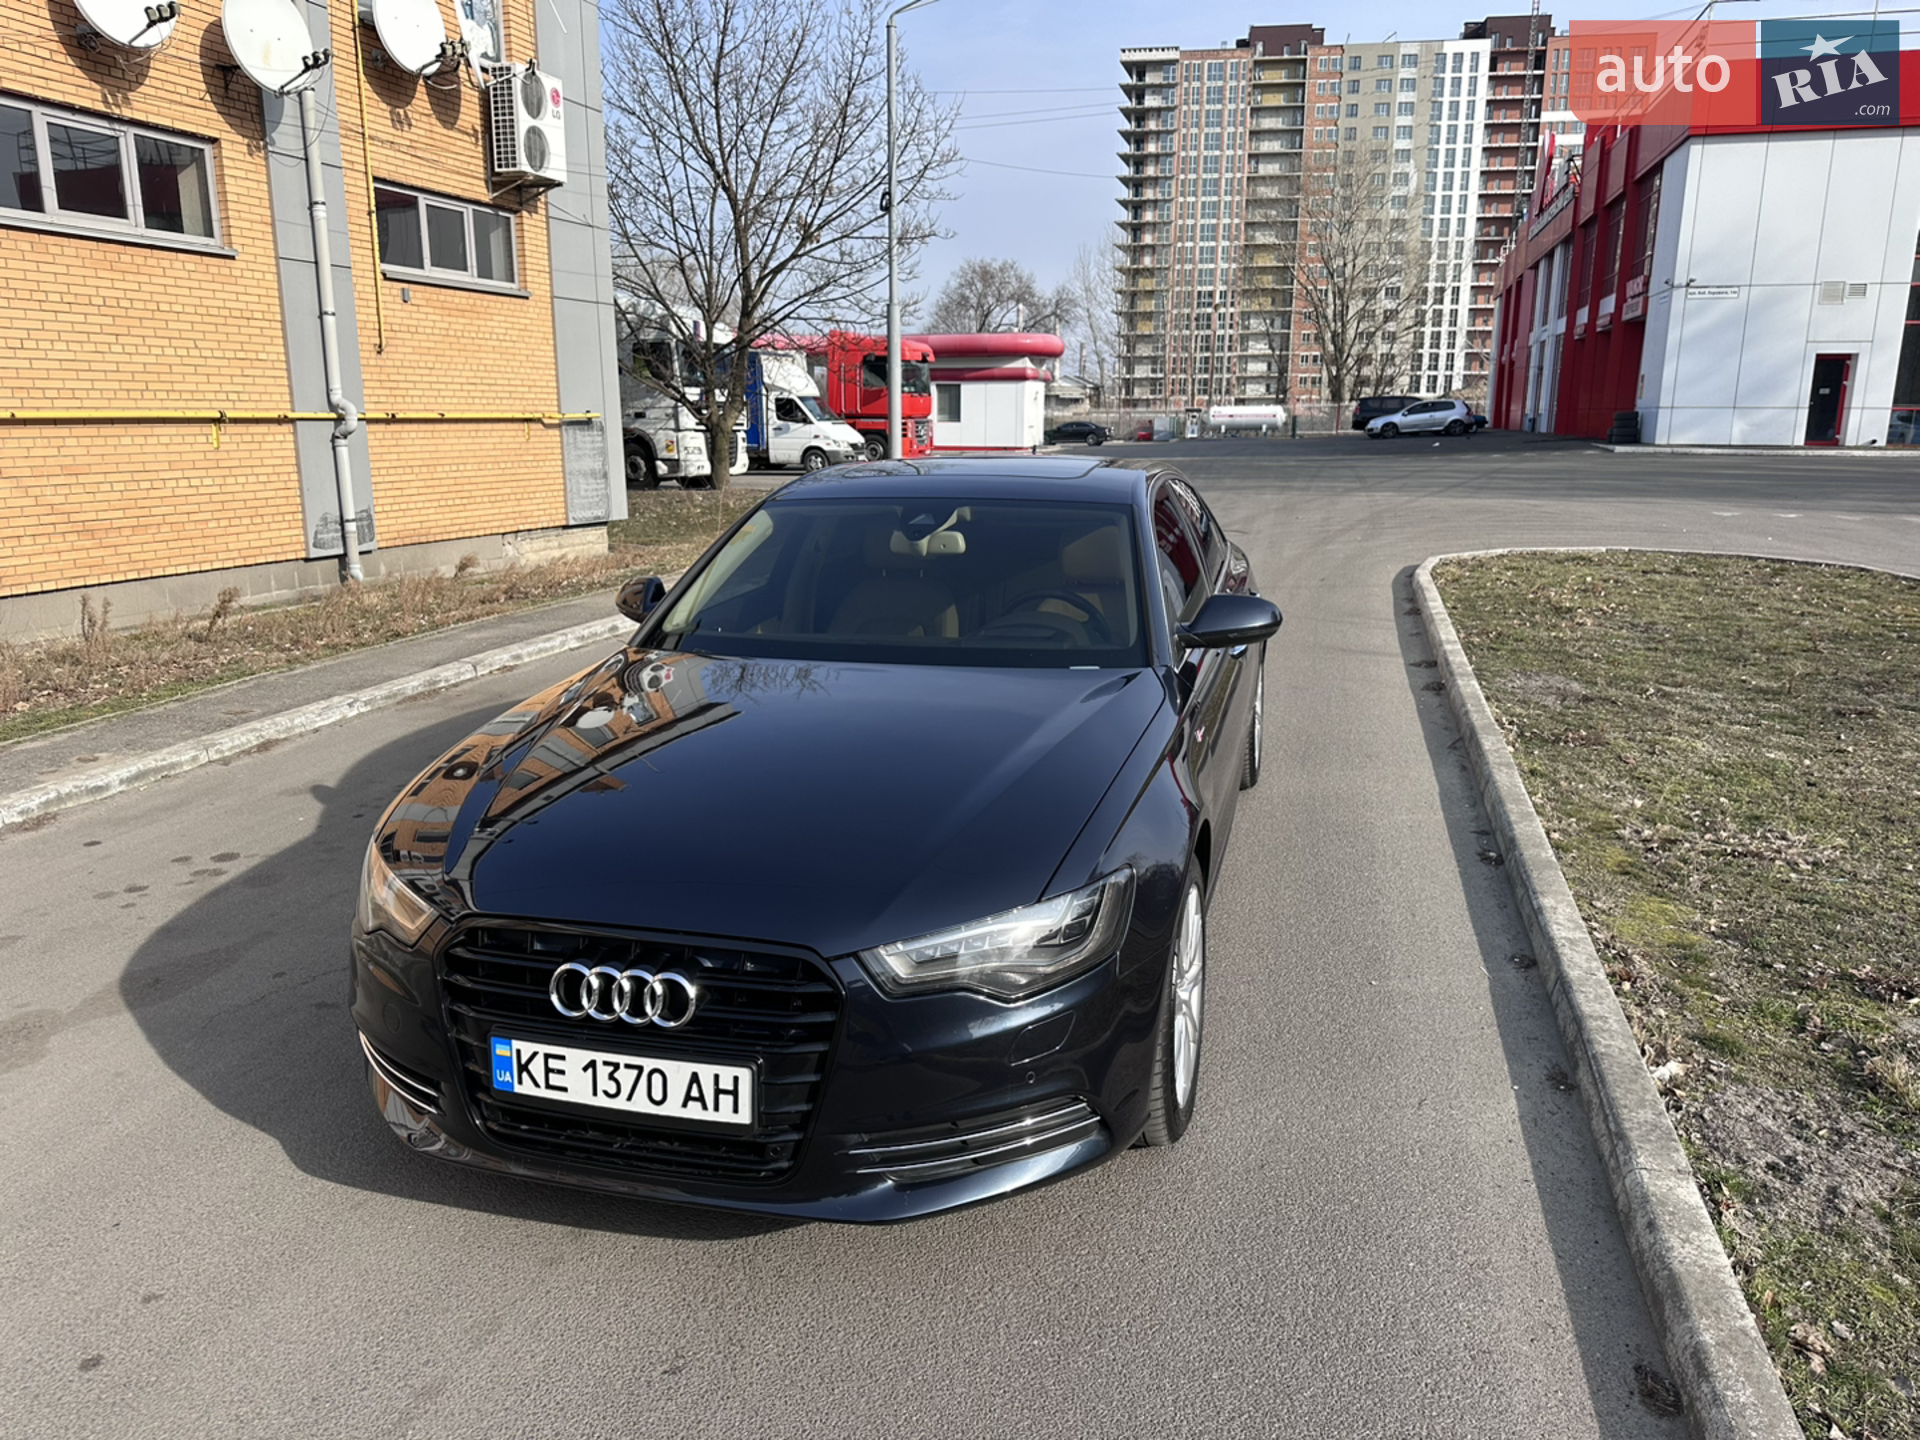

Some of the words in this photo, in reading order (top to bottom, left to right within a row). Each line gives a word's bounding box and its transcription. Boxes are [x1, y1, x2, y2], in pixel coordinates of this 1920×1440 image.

[551, 109, 561, 120] LG
[496, 1069, 512, 1083] UA
[515, 1048, 568, 1093] KE
[582, 1059, 668, 1106] 1370
[681, 1071, 739, 1114] AH
